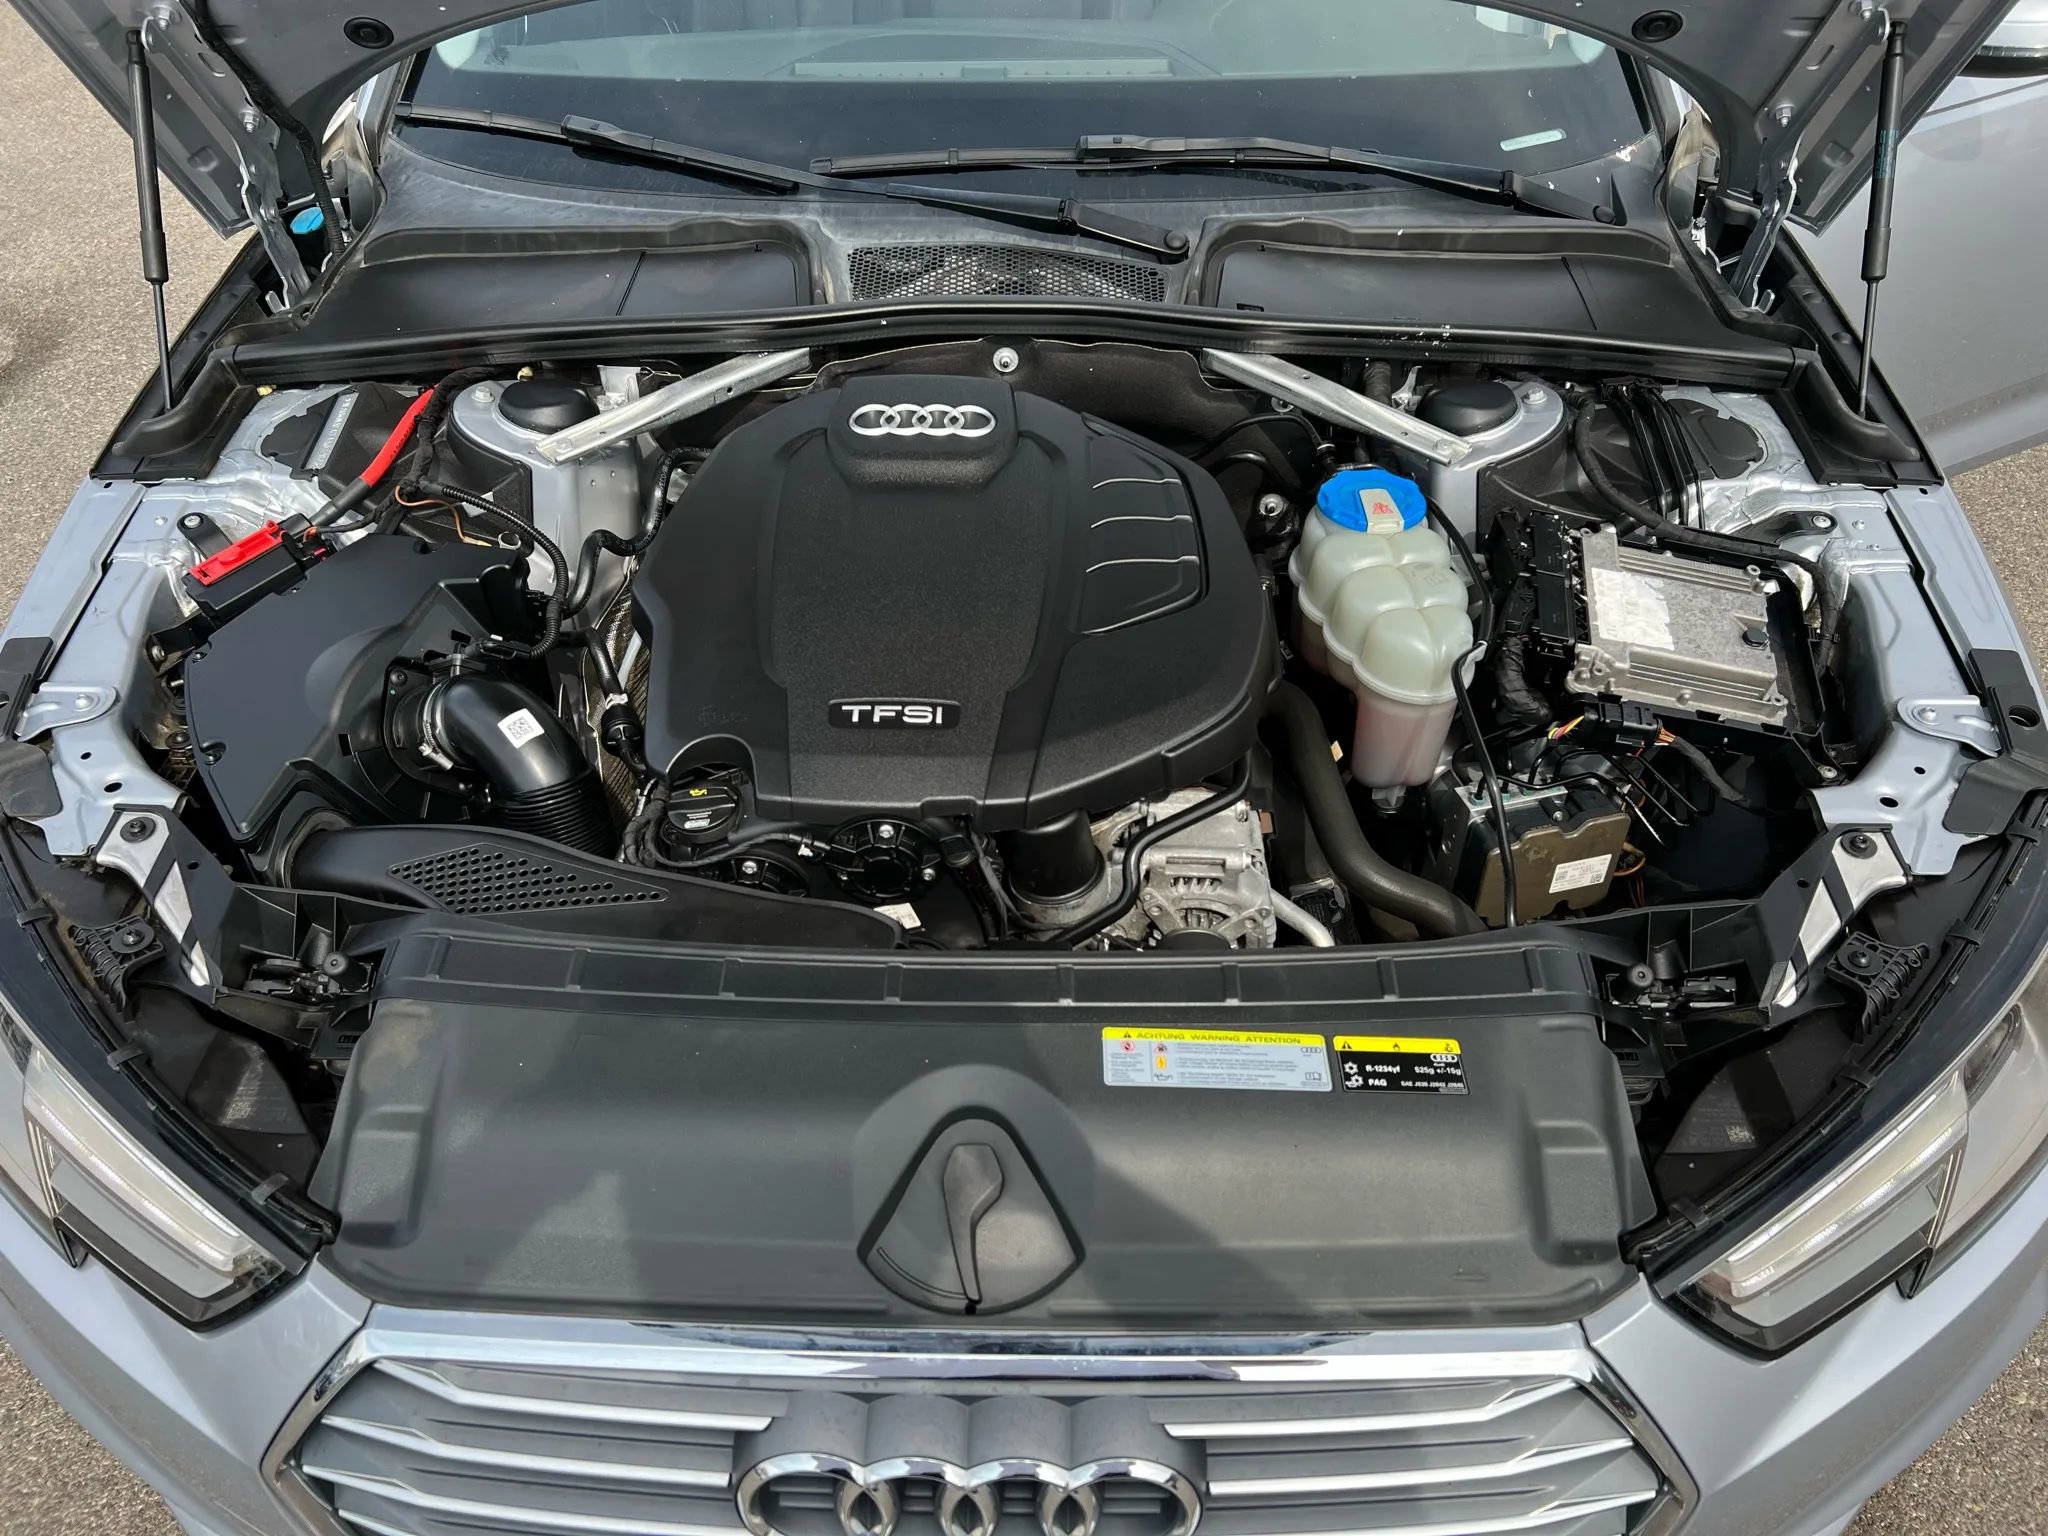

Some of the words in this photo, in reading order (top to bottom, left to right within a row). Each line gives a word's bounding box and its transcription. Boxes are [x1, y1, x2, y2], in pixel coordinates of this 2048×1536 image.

[841, 705, 943, 724] TFSI
[1136, 1032, 1185, 1040] ACHTUNG
[1190, 1033, 1240, 1041] WARNING
[1246, 1036, 1301, 1044] ATTENTION
[1368, 1078, 1388, 1087] PAG
